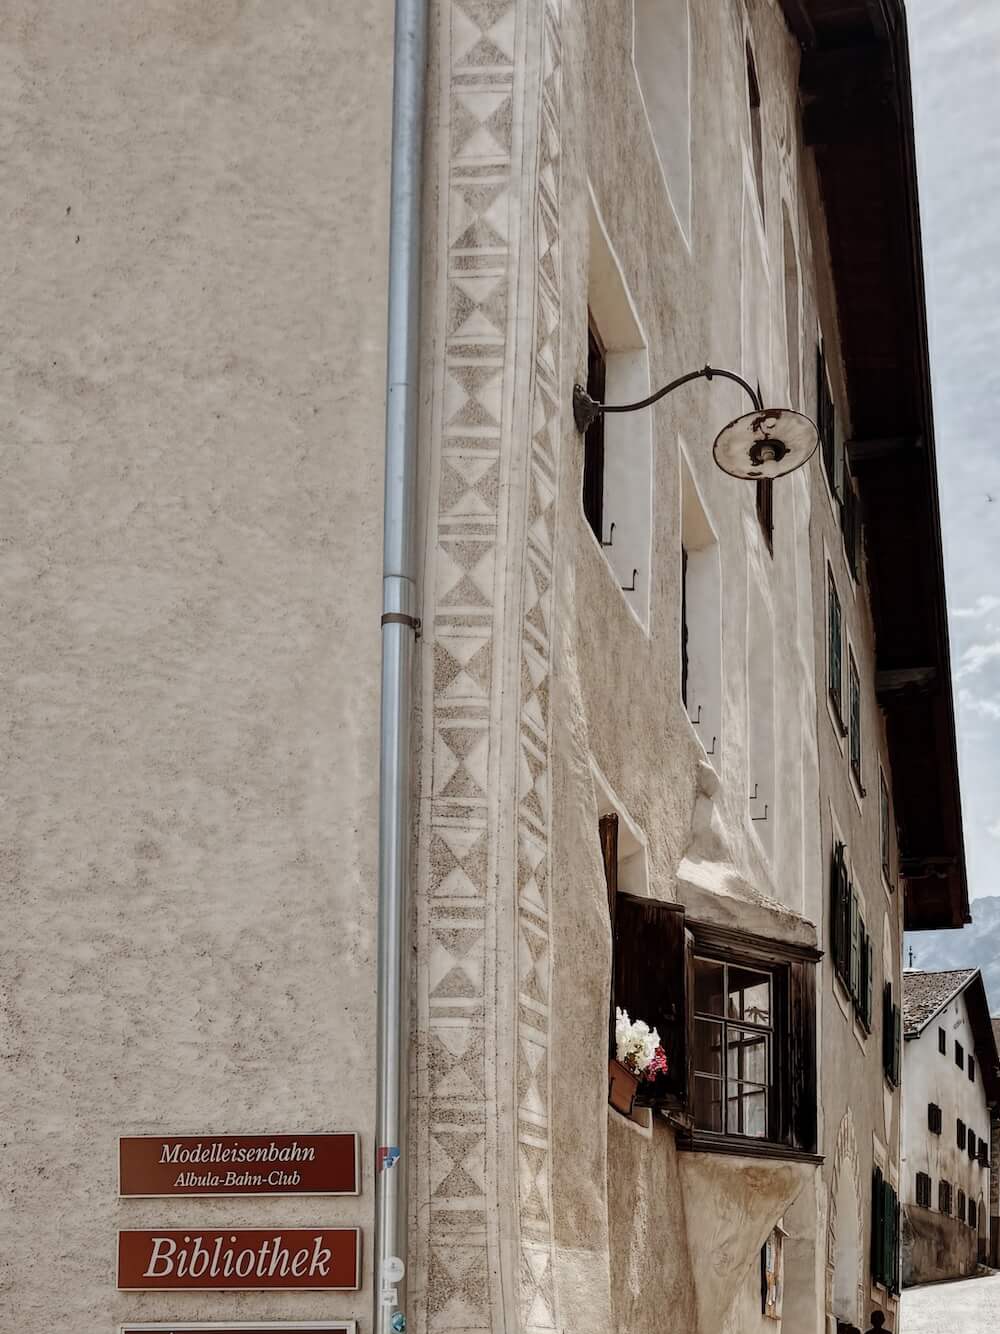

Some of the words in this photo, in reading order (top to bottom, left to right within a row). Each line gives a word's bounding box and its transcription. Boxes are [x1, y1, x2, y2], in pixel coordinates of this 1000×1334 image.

[159, 1142, 315, 1163] Modelleisenbahn
[174, 1171, 301, 1187] Albula-Bahn-Club
[143, 1236, 331, 1278] Bibliothek
